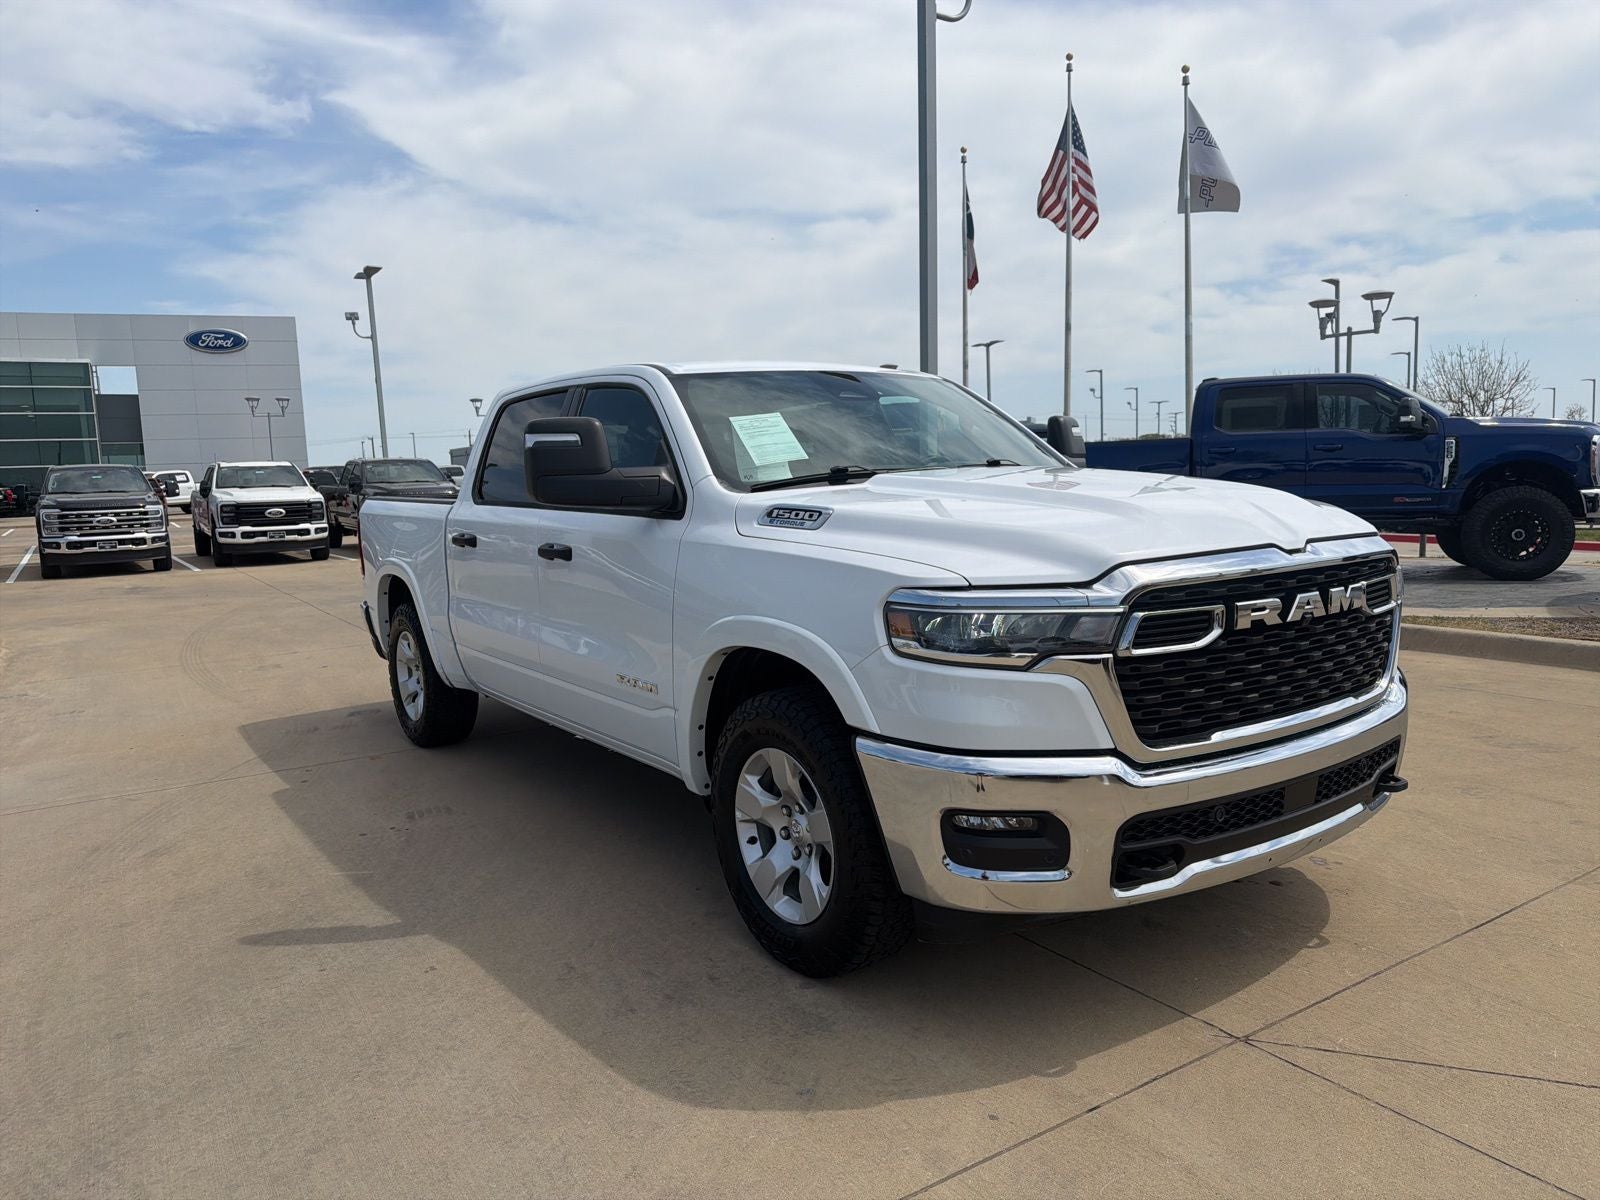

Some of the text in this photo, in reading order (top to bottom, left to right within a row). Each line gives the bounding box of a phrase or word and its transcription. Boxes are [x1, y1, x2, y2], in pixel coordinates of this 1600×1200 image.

[198, 333, 234, 348] Ford
[771, 509, 820, 520] 1500
[1234, 581, 1367, 630] RAM
